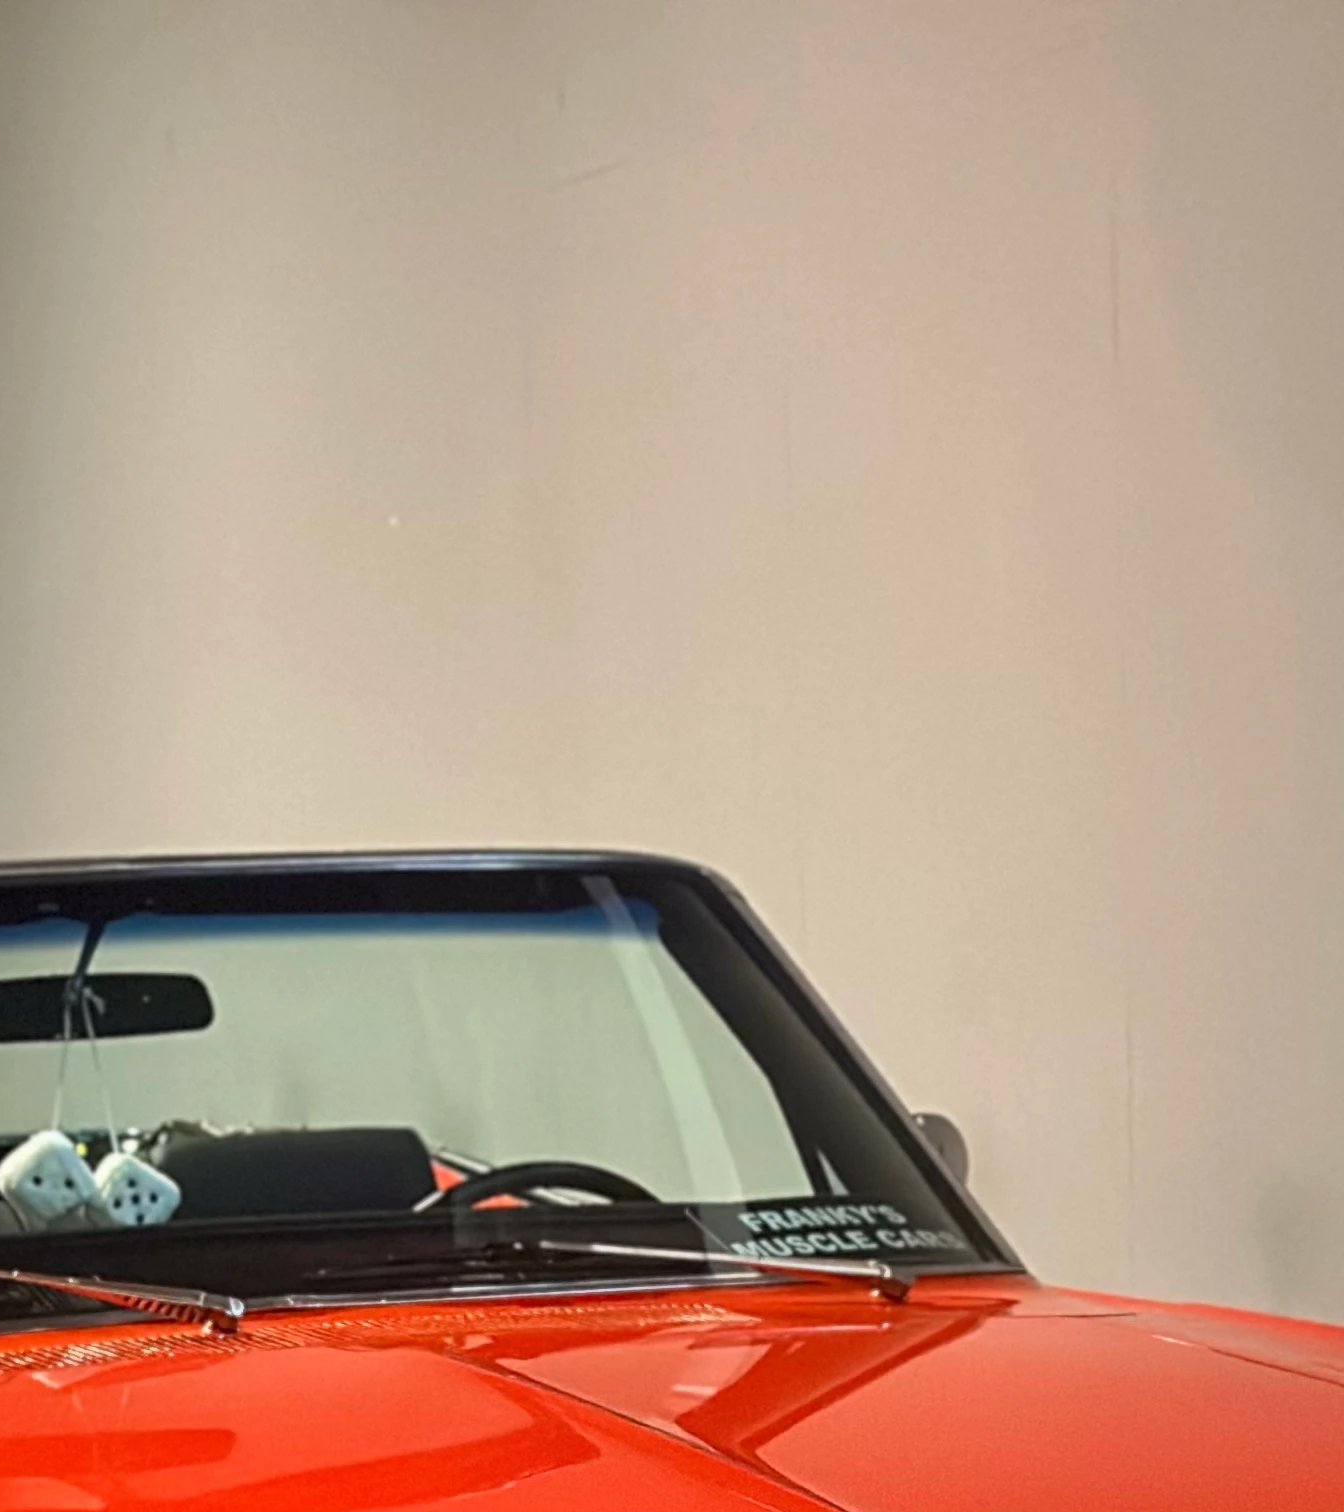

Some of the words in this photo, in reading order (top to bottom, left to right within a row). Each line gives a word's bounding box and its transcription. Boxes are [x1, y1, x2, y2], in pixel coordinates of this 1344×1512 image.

[737, 1204, 907, 1233] FRANKY'S
[730, 1230, 878, 1259] MUSCLE
[877, 1229, 965, 1250] CARS
